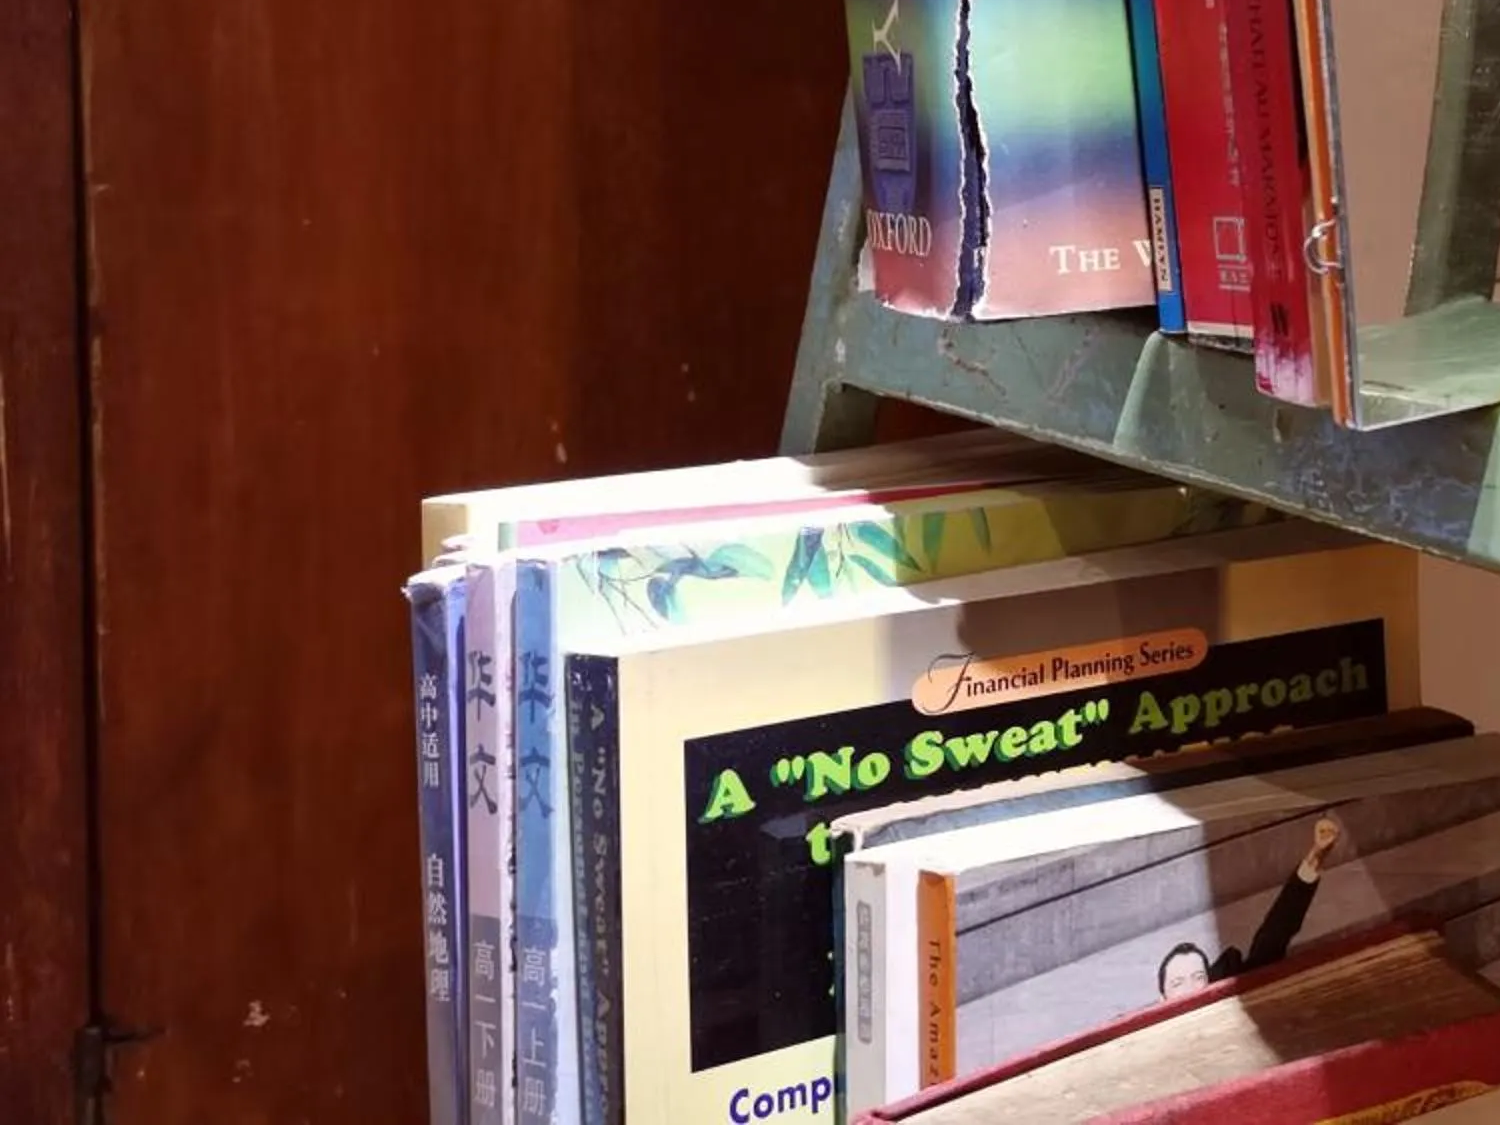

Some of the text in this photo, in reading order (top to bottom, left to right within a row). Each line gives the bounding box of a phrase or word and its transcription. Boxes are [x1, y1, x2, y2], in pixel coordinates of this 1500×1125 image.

[867, 208, 932, 257] OXFORD
[923, 638, 1195, 714] Financial Planning Series
[700, 657, 1369, 825] A "No Sweat" Approach
[928, 940, 942, 988] The
